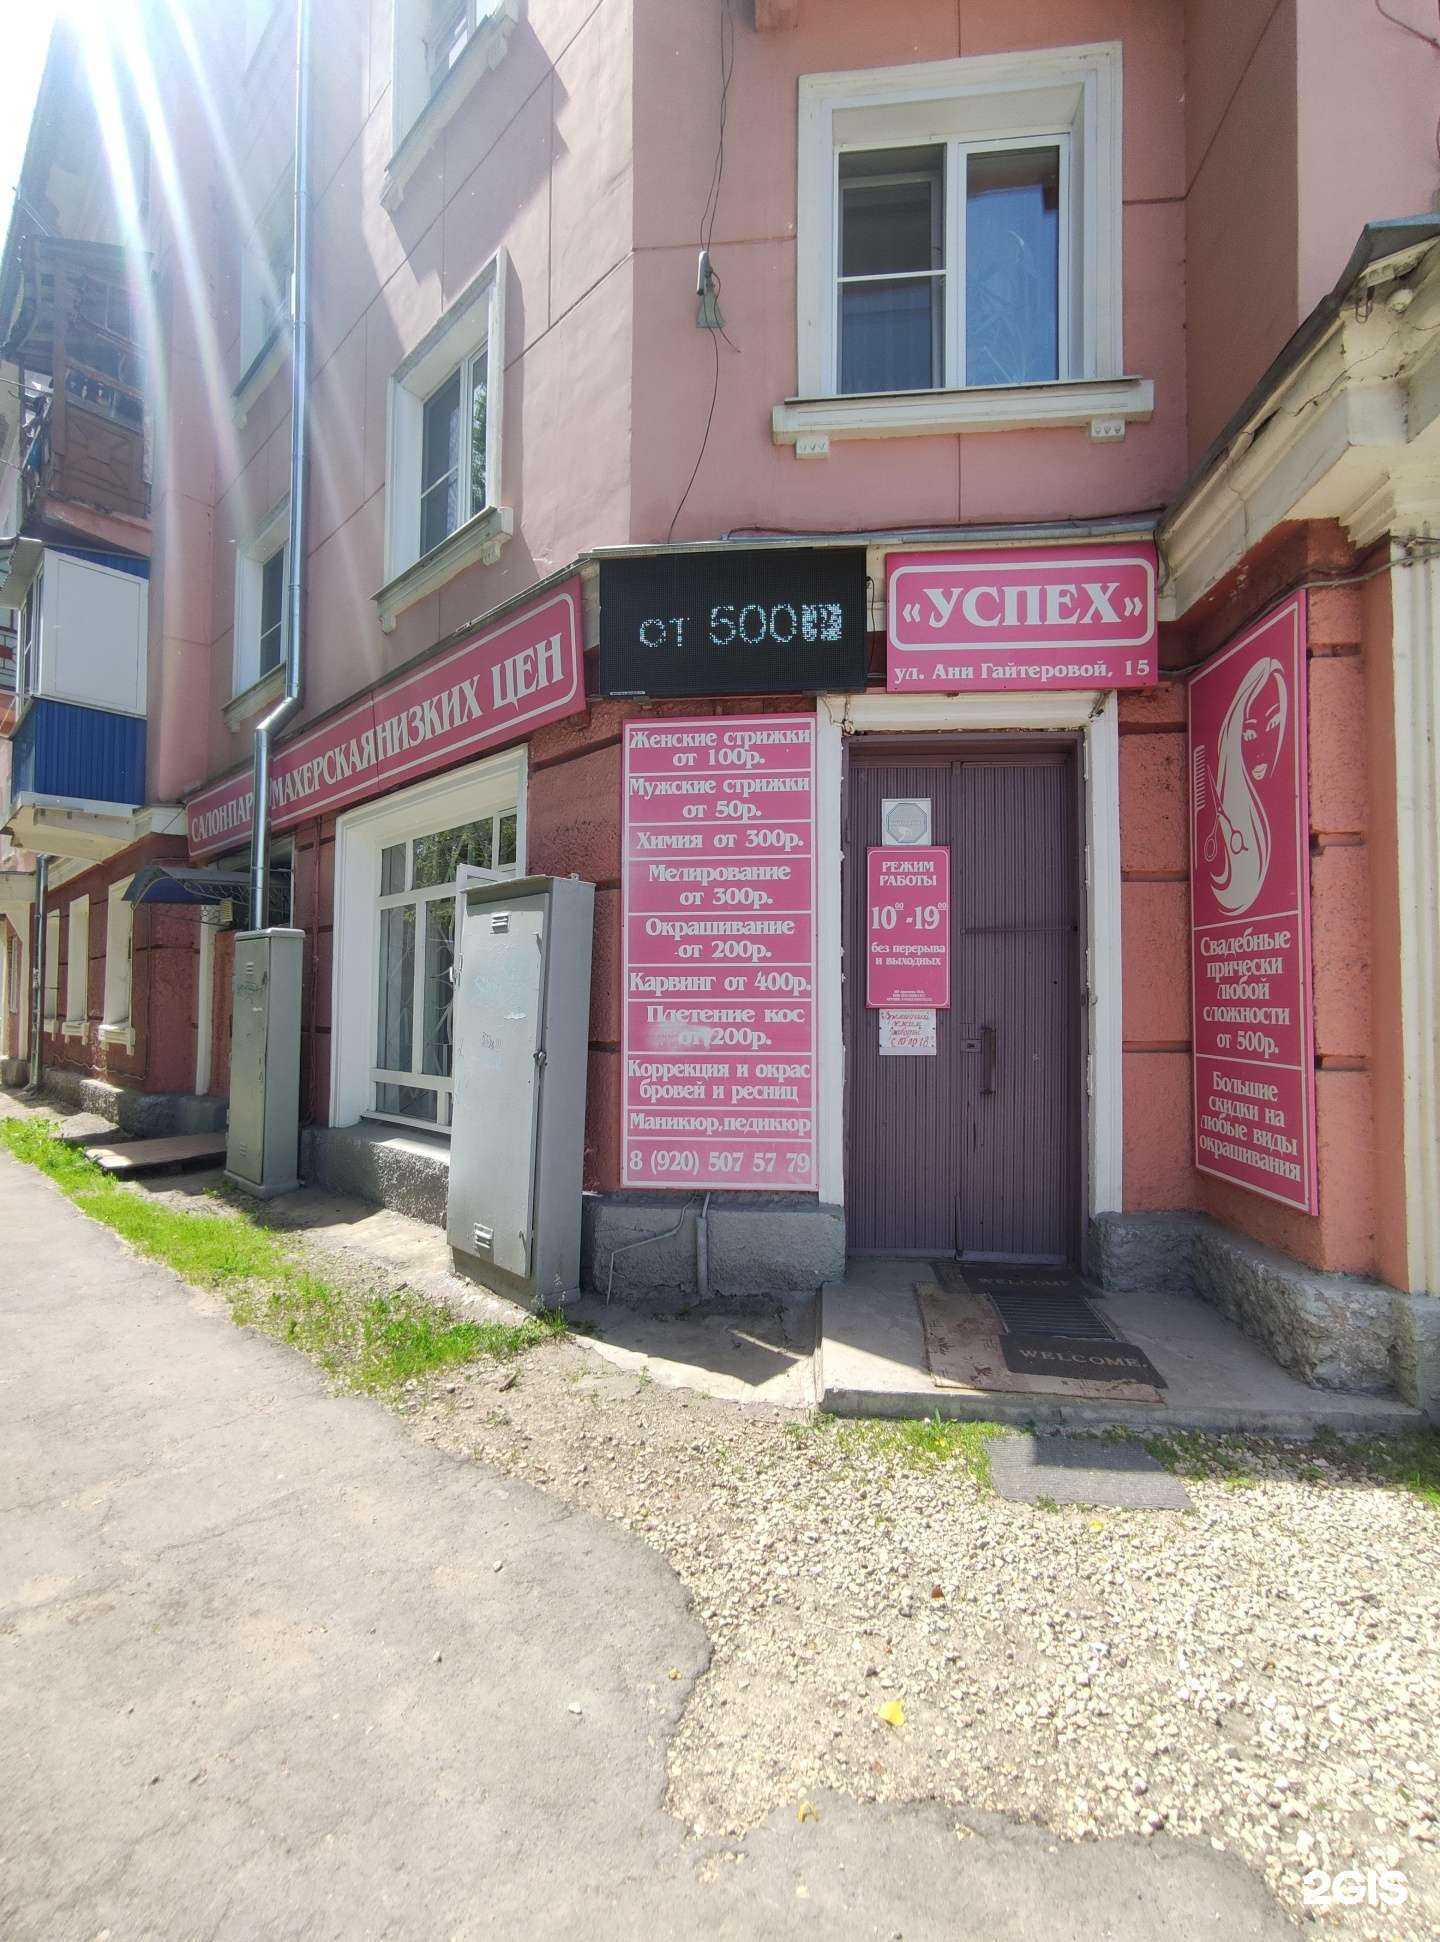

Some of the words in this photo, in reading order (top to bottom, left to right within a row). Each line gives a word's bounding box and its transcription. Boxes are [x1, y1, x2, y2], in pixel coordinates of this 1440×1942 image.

[902, 582, 1143, 628] «УСПЕХ»
[894, 665, 925, 684] ул.
[932, 663, 974, 680] Ани
[981, 660, 1113, 682] Гайтеровой,
[1124, 659, 1150, 677] 15
[376, 676, 482, 761] НИЗКИХ
[491, 632, 565, 712] ЦЕН
[630, 731, 717, 749] Женские
[723, 729, 811, 749] стрижки
[672, 753, 697, 767] от
[708, 749, 765, 769] 100р.
[629, 778, 717, 800] Мужские
[723, 777, 810, 797] стрижки
[682, 804, 707, 818] от
[715, 800, 762, 822] 50р.
[636, 832, 703, 849] Химия
[713, 834, 738, 848] от
[745, 830, 804, 852] 300р.
[649, 864, 791, 886] Мелирование
[882, 861, 934, 872] РЕЖИМ
[880, 875, 937, 886] РАБОТЫ
[679, 891, 704, 905] от
[712, 888, 774, 910] 300р.
[645, 917, 796, 940] Окрашивание
[711, 941, 773, 962] 200р.
[871, 942, 890, 953] без
[893, 944, 946, 956] перерыва
[1200, 927, 1291, 958] Свадебные
[876, 958, 883, 966] и
[886, 957, 941, 967] выходных
[1206, 957, 1283, 983] прически
[630, 973, 716, 996] Карвинг
[724, 978, 747, 991] от
[755, 972, 811, 996] 400р.
[1217, 976, 1270, 1000] любой
[647, 1006, 755, 1023] Плетение
[764, 1008, 805, 1023] кос
[1203, 1007, 1290, 1025] сложности
[711, 1027, 772, 1050] 200р.
[1217, 1033, 1231, 1048] от
[1237, 1031, 1279, 1058] 500р.
[628, 1060, 730, 1081] Коррекция
[736, 1064, 749, 1077] и
[755, 1063, 811, 1083] окрас
[640, 1081, 705, 1103] бровей
[712, 1085, 725, 1098] и
[731, 1084, 799, 1104] ресниц
[1212, 1071, 1278, 1102] Большие
[1209, 1096, 1258, 1121] скидки
[1265, 1108, 1285, 1127] на
[1200, 1112, 1247, 1140] любые
[1253, 1128, 1298, 1156] виды
[630, 1151, 643, 1170] 8
[650, 1150, 699, 1175] (920)
[708, 1152, 744, 1172] 507
[752, 1152, 777, 1172] 57
[786, 1153, 811, 1173] 79
[1200, 1135, 1301, 1183] окрашивания
